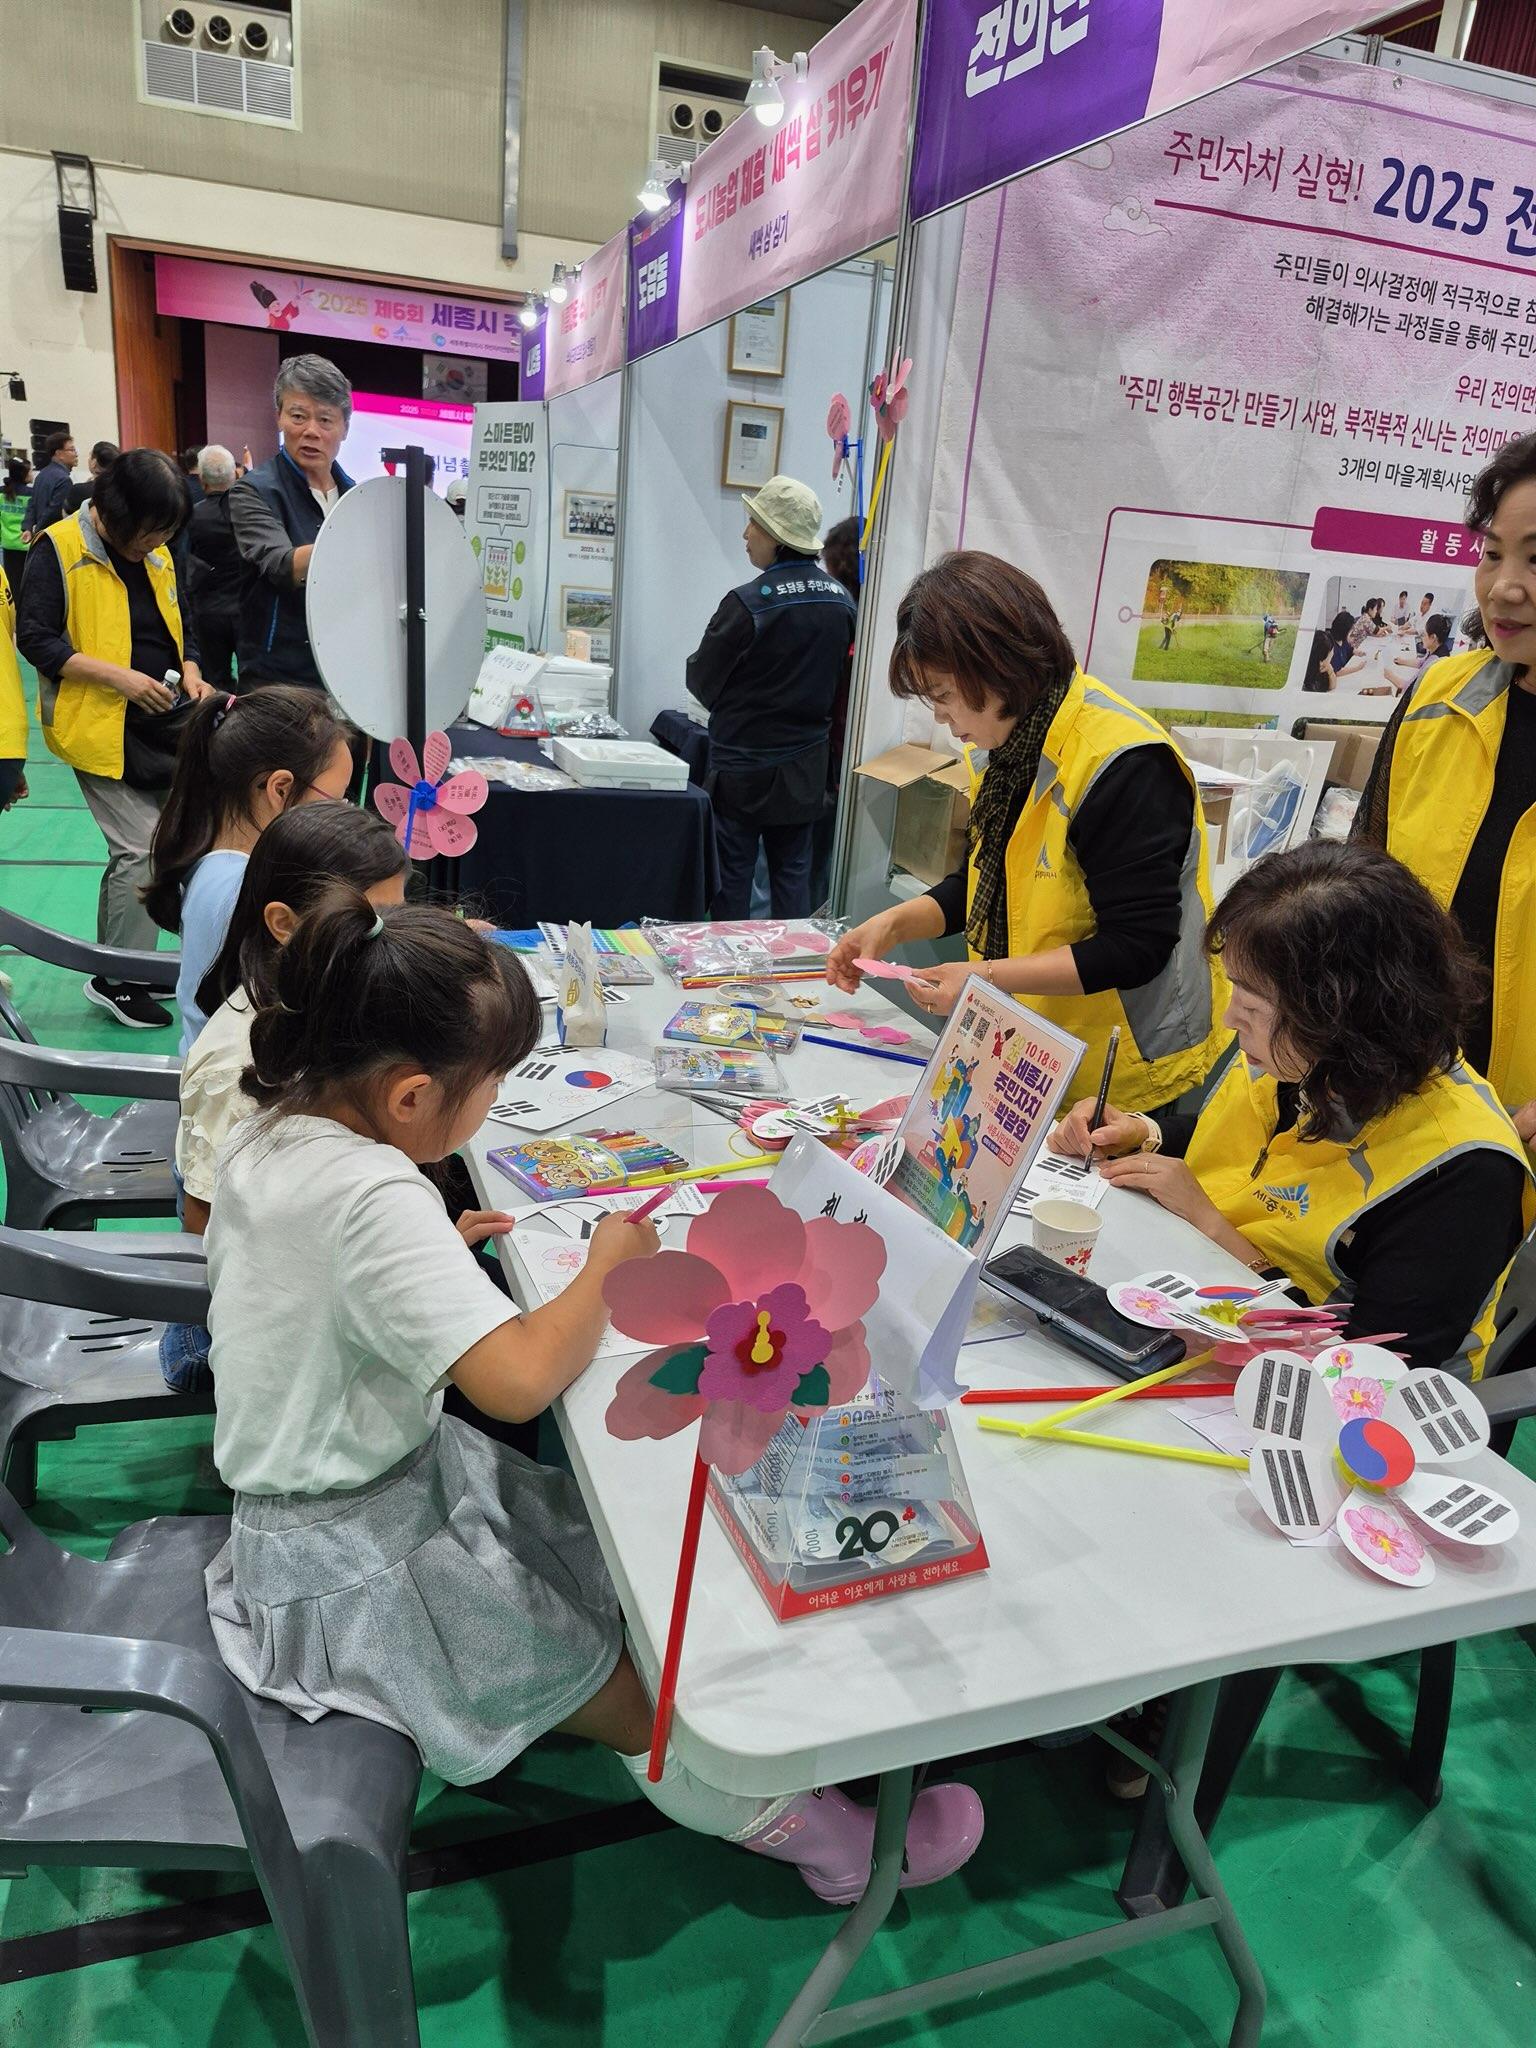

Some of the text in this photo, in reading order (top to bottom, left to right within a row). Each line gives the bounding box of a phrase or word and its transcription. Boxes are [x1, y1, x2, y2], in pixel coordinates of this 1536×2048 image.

[695, 168, 739, 241] 도시농업
[740, 144, 767, 208] 체험
[1163, 130, 1284, 192] 주민자치
[1292, 152, 1365, 204] 실현!
[1373, 158, 1494, 236] 2025
[638, 251, 669, 311] 도담동
[1273, 253, 1349, 288] 주민들이
[1353, 267, 1438, 305] 의사결정에
[1442, 284, 1521, 319] 적극적으로
[318, 291, 369, 317] 2025
[374, 299, 425, 324] 제6회
[431, 303, 497, 334] 세종시
[1306, 295, 1536, 358] 해결해가는 과정들을 통해 주민
[1118, 375, 1163, 413] "주민
[1168, 381, 1239, 422] 행복공간
[1244, 391, 1298, 430] 만들기
[1301, 401, 1338, 438] 사업,
[1344, 407, 1408, 447] 북적북적
[1411, 417, 1457, 454] 신나는
[1455, 376, 1536, 415] 우리 전의면
[483, 422, 534, 445] 스마트팜이
[479, 450, 536, 472] 무엇인가요?
[1338, 457, 1476, 496] 3개의 마을계획사업
[776, 580, 845, 595] 도담동 주민자
[994, 1070, 1042, 1120] 주민자치
[1013, 1057, 1053, 1097] 세종시
[994, 1101, 1031, 1143] 박람회
[1252, 1190, 1279, 1212] 세종
[835, 1510, 899, 1561] 20
[808, 1591, 839, 1608] 어려운
[844, 1579, 884, 1598] 이웃에게
[887, 1572, 917, 1589] 사랑을
